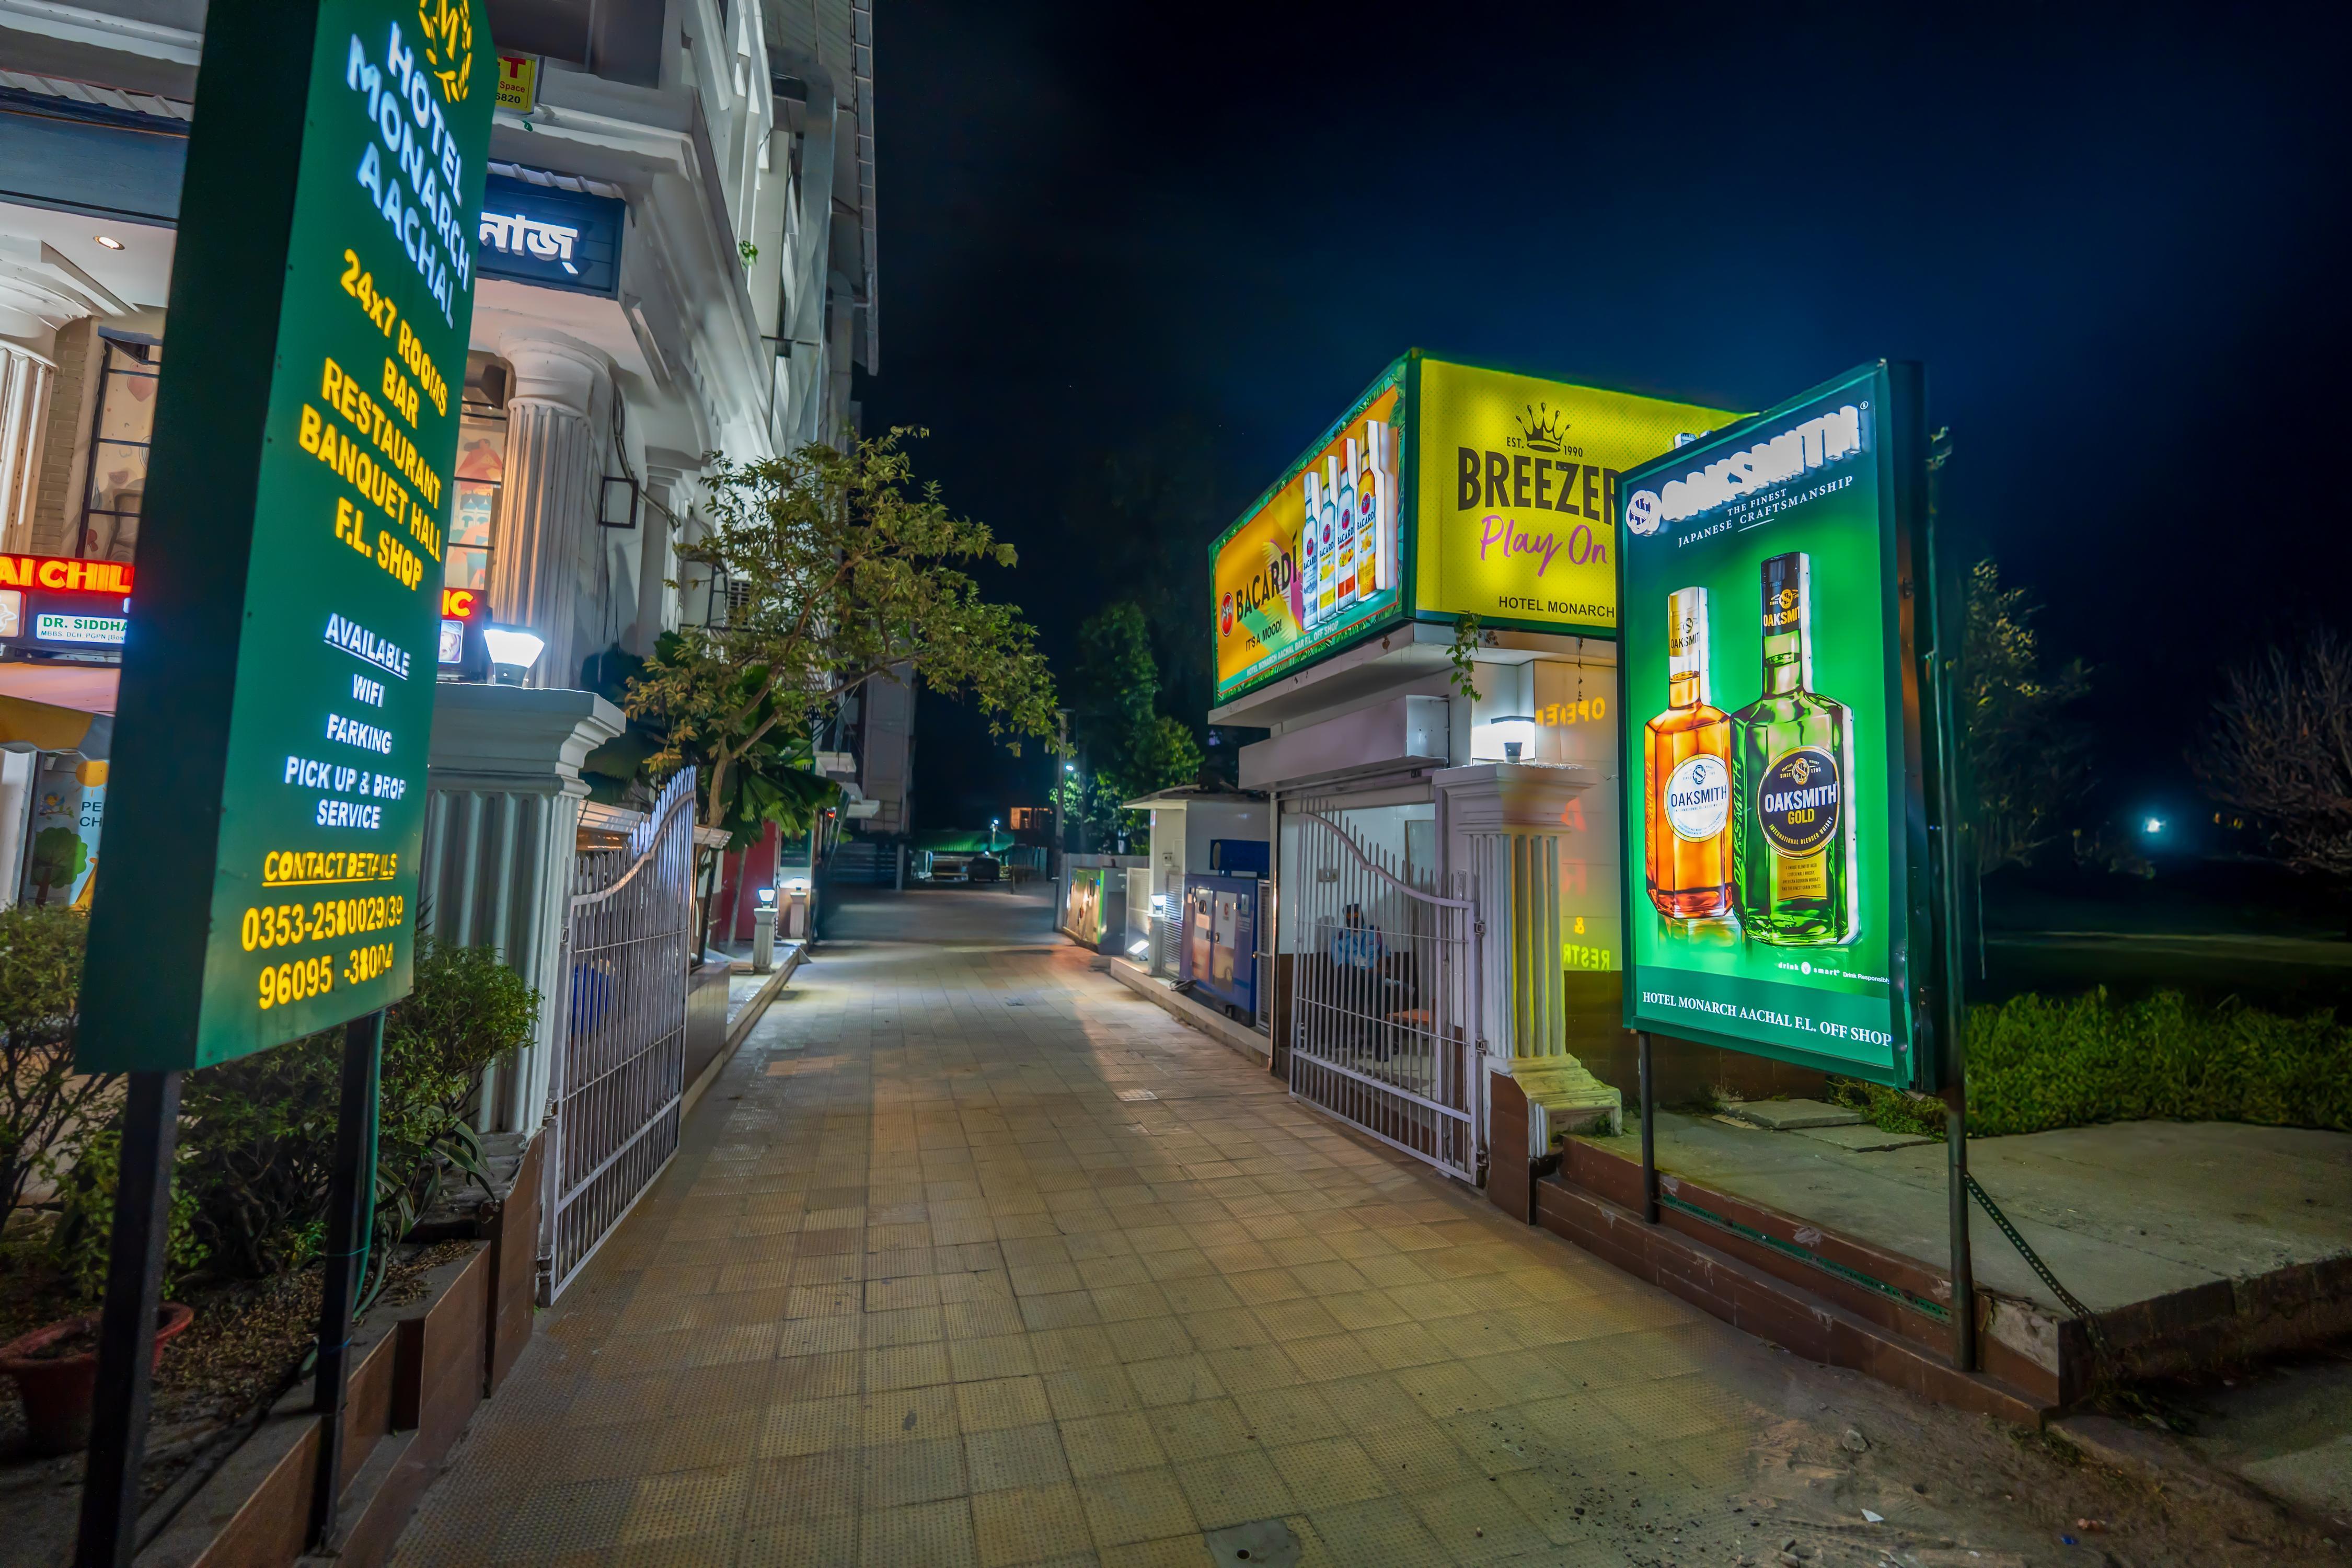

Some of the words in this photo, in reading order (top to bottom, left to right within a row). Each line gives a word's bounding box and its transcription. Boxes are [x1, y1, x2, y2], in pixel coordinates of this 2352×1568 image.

[497, 56, 526, 79] T
[500, 80, 525, 93] Space
[388, 20, 463, 207] HOTEL
[347, 33, 470, 292] MONARCH
[358, 142, 454, 329] AACHAL
[340, 248, 397, 338] 24x7
[398, 319, 448, 417] ROOMS
[382, 357, 419, 429] BAR
[322, 357, 442, 510] RESTAURANT
[1507, 436, 1524, 448] EST.
[1563, 445, 1583, 457] 1990
[298, 403, 409, 525] BANQUET
[410, 502, 441, 563] HALL
[1458, 447, 1617, 525] BREEZER
[1678, 521, 1733, 548] JAPANESE
[1739, 476, 1852, 524] CRAFTSMANSHIP
[1727, 504, 1747, 516] THE
[1750, 489, 1786, 508] FINEST
[336, 497, 372, 558] F.L.
[377, 529, 423, 591] SHOP
[1480, 514, 1563, 578] Play
[1569, 524, 1608, 565] On
[39, 560, 131, 593] CHIL
[442, 590, 474, 617] IC
[1499, 595, 1543, 612] HOTEL
[1548, 601, 1615, 618] MONARCH
[43, 617, 67, 628] DR.
[1256, 632, 1261, 646] A
[1262, 619, 1282, 642] MOOD!
[325, 613, 411, 677] AVAILABLE
[1247, 667, 1258, 677] HOTEL
[1259, 653, 1277, 670] MONARCH
[1278, 644, 1295, 660] AACHAL
[1295, 640, 1304, 651] BAR
[1313, 630, 1323, 641] OFF
[1324, 620, 1339, 636] SHOP
[352, 674, 385, 707] WIFI
[327, 713, 392, 755] PARKING
[284, 755, 332, 790] PICK
[333, 766, 357, 793] UP
[359, 774, 370, 795] &
[373, 775, 406, 800] DROP
[82, 802, 102, 812] PE
[1671, 785, 1727, 808] OAKSMITH
[1765, 784, 1837, 813] OAKSMITH
[79, 816, 102, 827] CH
[316, 800, 381, 829] SERVICE
[1769, 824, 1798, 845] INTERNATIONAL
[1800, 833, 1819, 845] BLENDED
[1819, 816, 1834, 835] WHISKY
[1788, 808, 1815, 825] GOLD
[264, 851, 347, 882] CONTACT
[347, 852, 398, 879] DETAILS
[241, 895, 404, 952] 0353-2580029/39
[258, 954, 334, 1010] 96095
[1778, 962, 1798, 971] drink
[1814, 967, 1837, 976] smart
[1858, 973, 1890, 984] Responsibly
[1643, 992, 1677, 1007] HOTEL
[1678, 996, 1736, 1017] MONARCH
[1739, 1007, 1792, 1028] AACHAL
[1795, 1018, 1817, 1032] F.L.
[1820, 1021, 1848, 1039] OFF
[1851, 1027, 1892, 1047] SHOP
